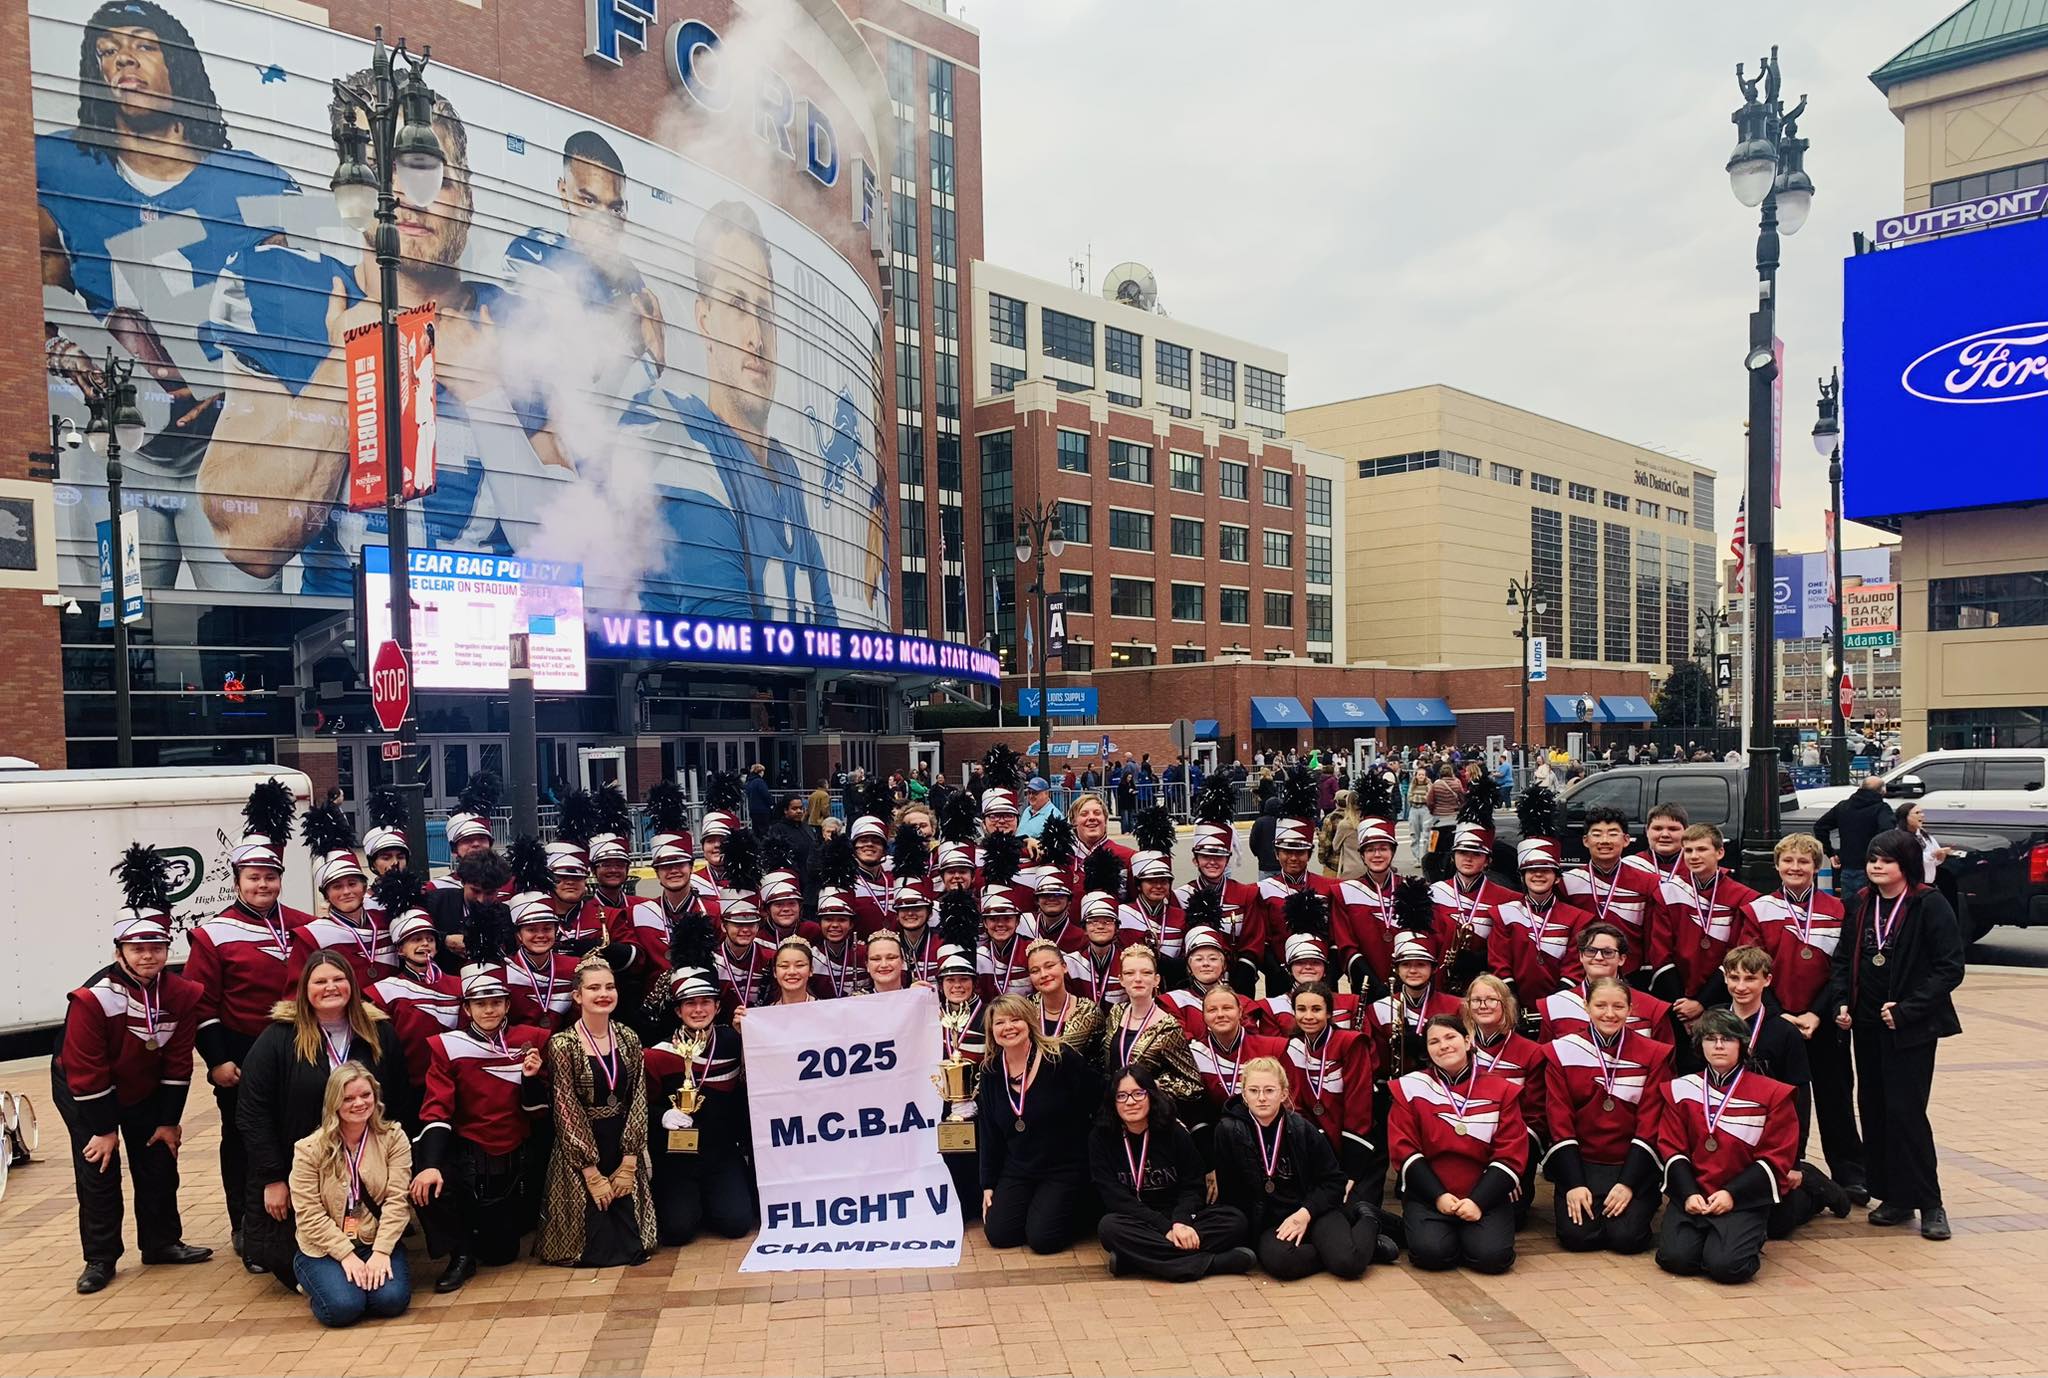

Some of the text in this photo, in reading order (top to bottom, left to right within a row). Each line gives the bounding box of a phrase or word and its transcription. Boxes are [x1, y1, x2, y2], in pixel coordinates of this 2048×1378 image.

[584, 0, 841, 188] FORD
[1882, 190, 2040, 239] OUTFRONT
[1945, 333, 2048, 393] For
[355, 373, 378, 465] OCTOBER
[1649, 473, 1671, 493] District
[1672, 480, 1689, 498] Court
[408, 553, 561, 581] LEAR BAG POLICY
[421, 579, 454, 592] CLEAR
[457, 581, 471, 593] ON
[474, 582, 517, 596] STADIUM
[1050, 602, 1063, 610] GATE
[1851, 606, 1879, 616] BAR
[1050, 613, 1065, 638] A
[1851, 617, 1889, 627] GRILL
[603, 617, 752, 651] WELCOME
[763, 627, 795, 654] TO
[804, 630, 841, 658] THE
[850, 634, 894, 663] 2025
[899, 640, 936, 667] MCBA
[940, 645, 969, 671] STATE
[1847, 633, 1892, 647] Adams E
[1534, 640, 1542, 668] LIONS
[1719, 664, 1731, 678] A
[375, 669, 405, 702] STOP
[1047, 692, 1086, 702] LIONS SUPPLY
[1053, 745, 1069, 753] GATE
[1066, 740, 1079, 759] A
[195, 894, 238, 905] High Scho
[797, 1040, 897, 1080] 2025
[770, 1101, 936, 1148] M.C.B.A.
[767, 1184, 949, 1229] FLIGHT V
[756, 1239, 956, 1255] CHAMPION
